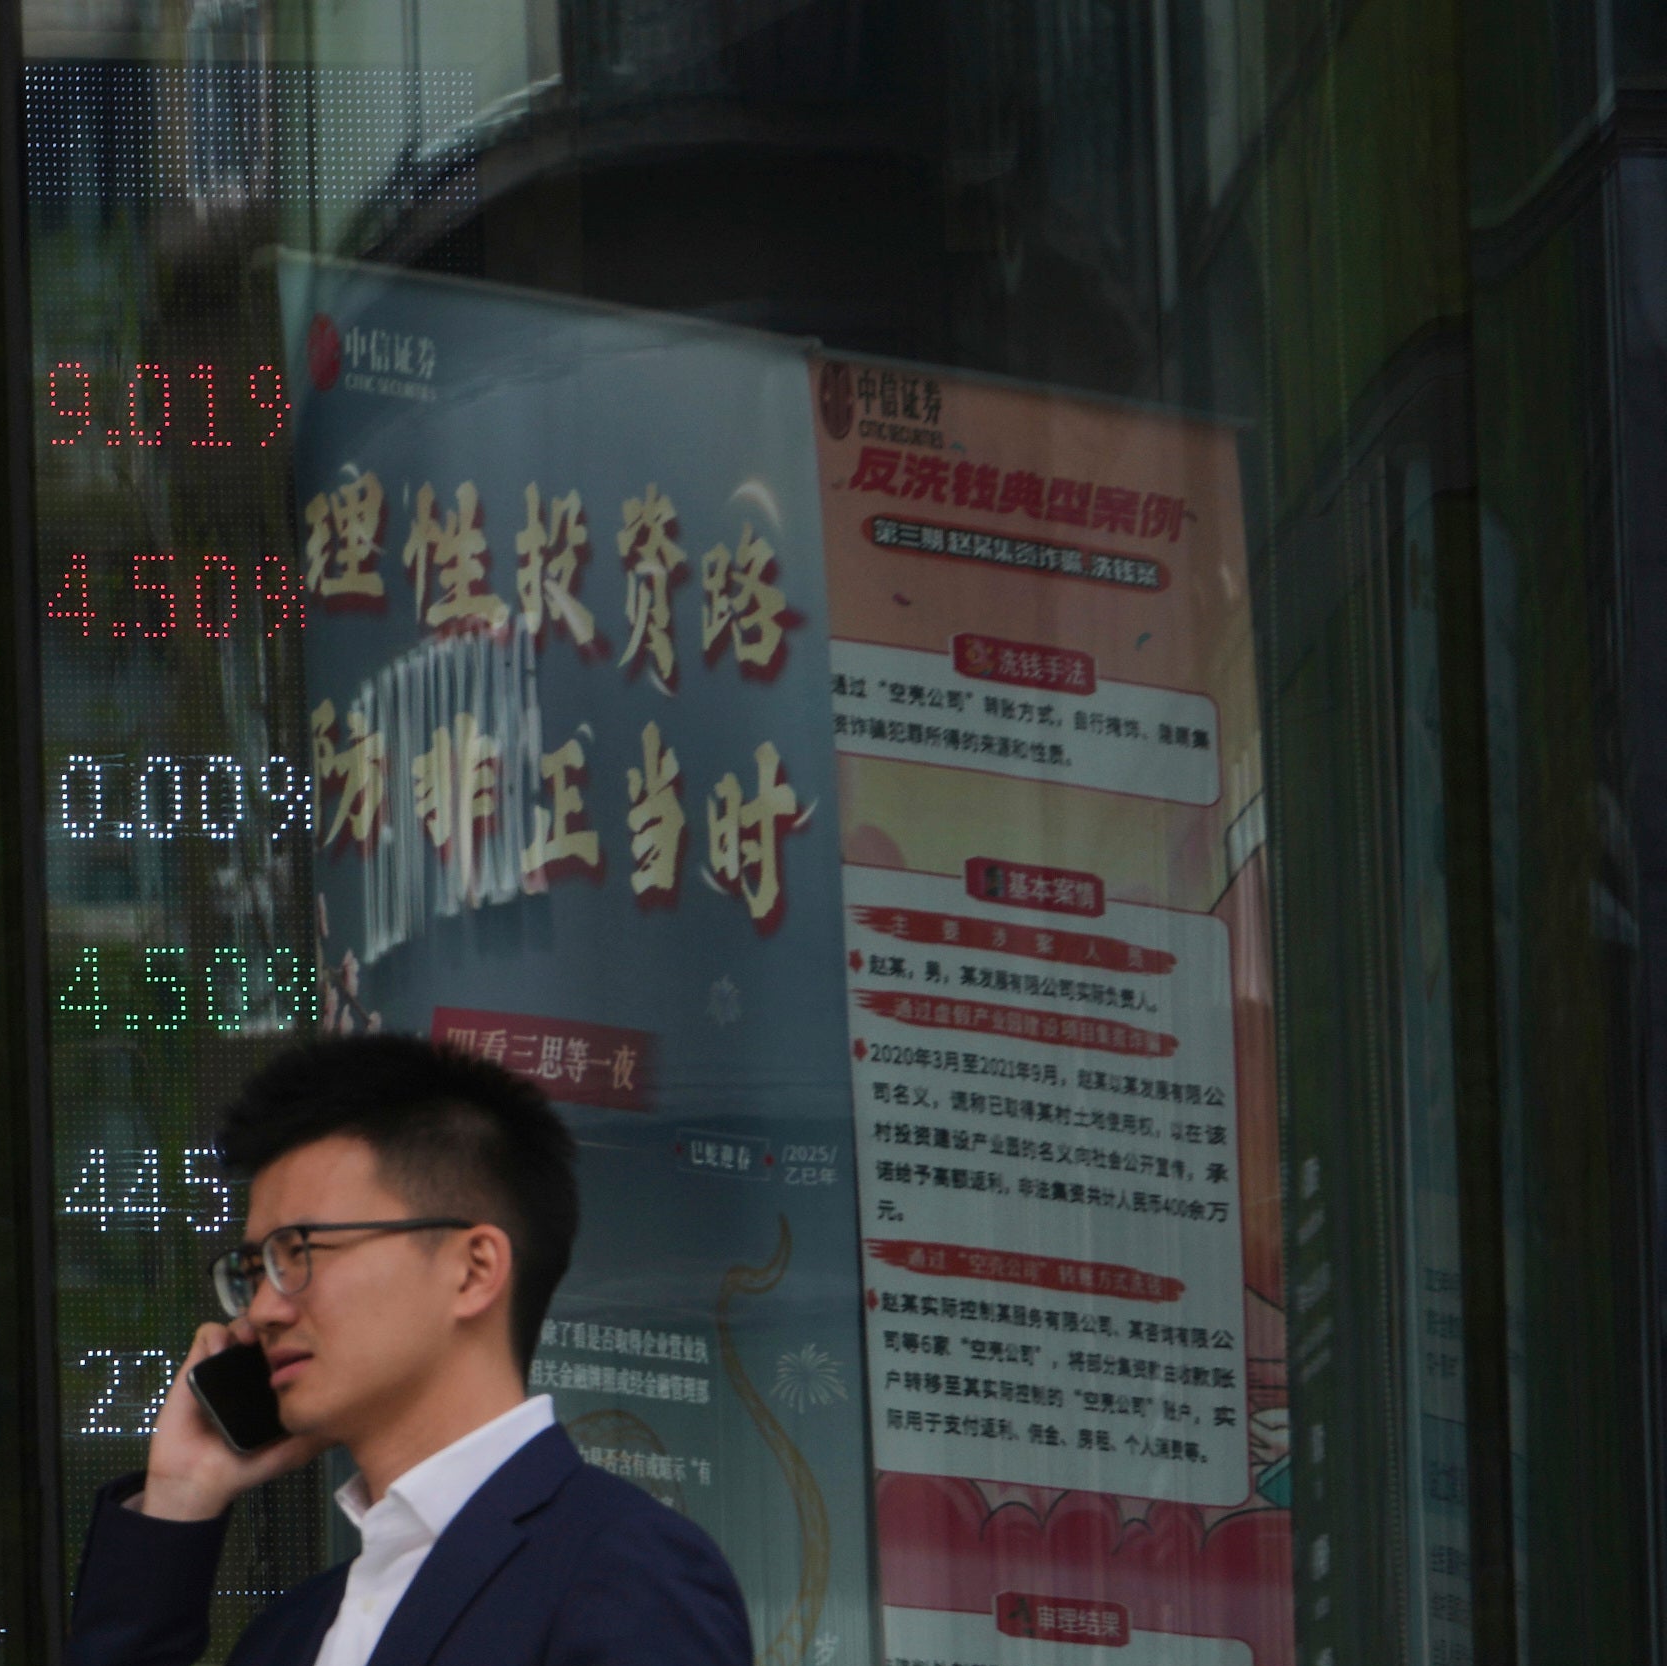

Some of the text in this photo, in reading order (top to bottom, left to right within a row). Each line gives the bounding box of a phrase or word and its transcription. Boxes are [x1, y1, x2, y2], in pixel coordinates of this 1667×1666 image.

[345, 324, 439, 378] 中信证券
[857, 369, 943, 425] 中信证券
[850, 447, 1185, 541] 反洗钱典型案例
[304, 471, 789, 682] 理性投资路
[998, 649, 1088, 687] 洗钱手法
[61, 754, 313, 840] 0.00%
[311, 698, 797, 920] 防非正当时
[1008, 870, 1096, 910] 基本案情
[60, 946, 317, 1031] 4.50%
[65, 1147, 229, 1232] 445
[877, 1199, 905, 1224] 元。
[1036, 1604, 1120, 1638] 审理结果
